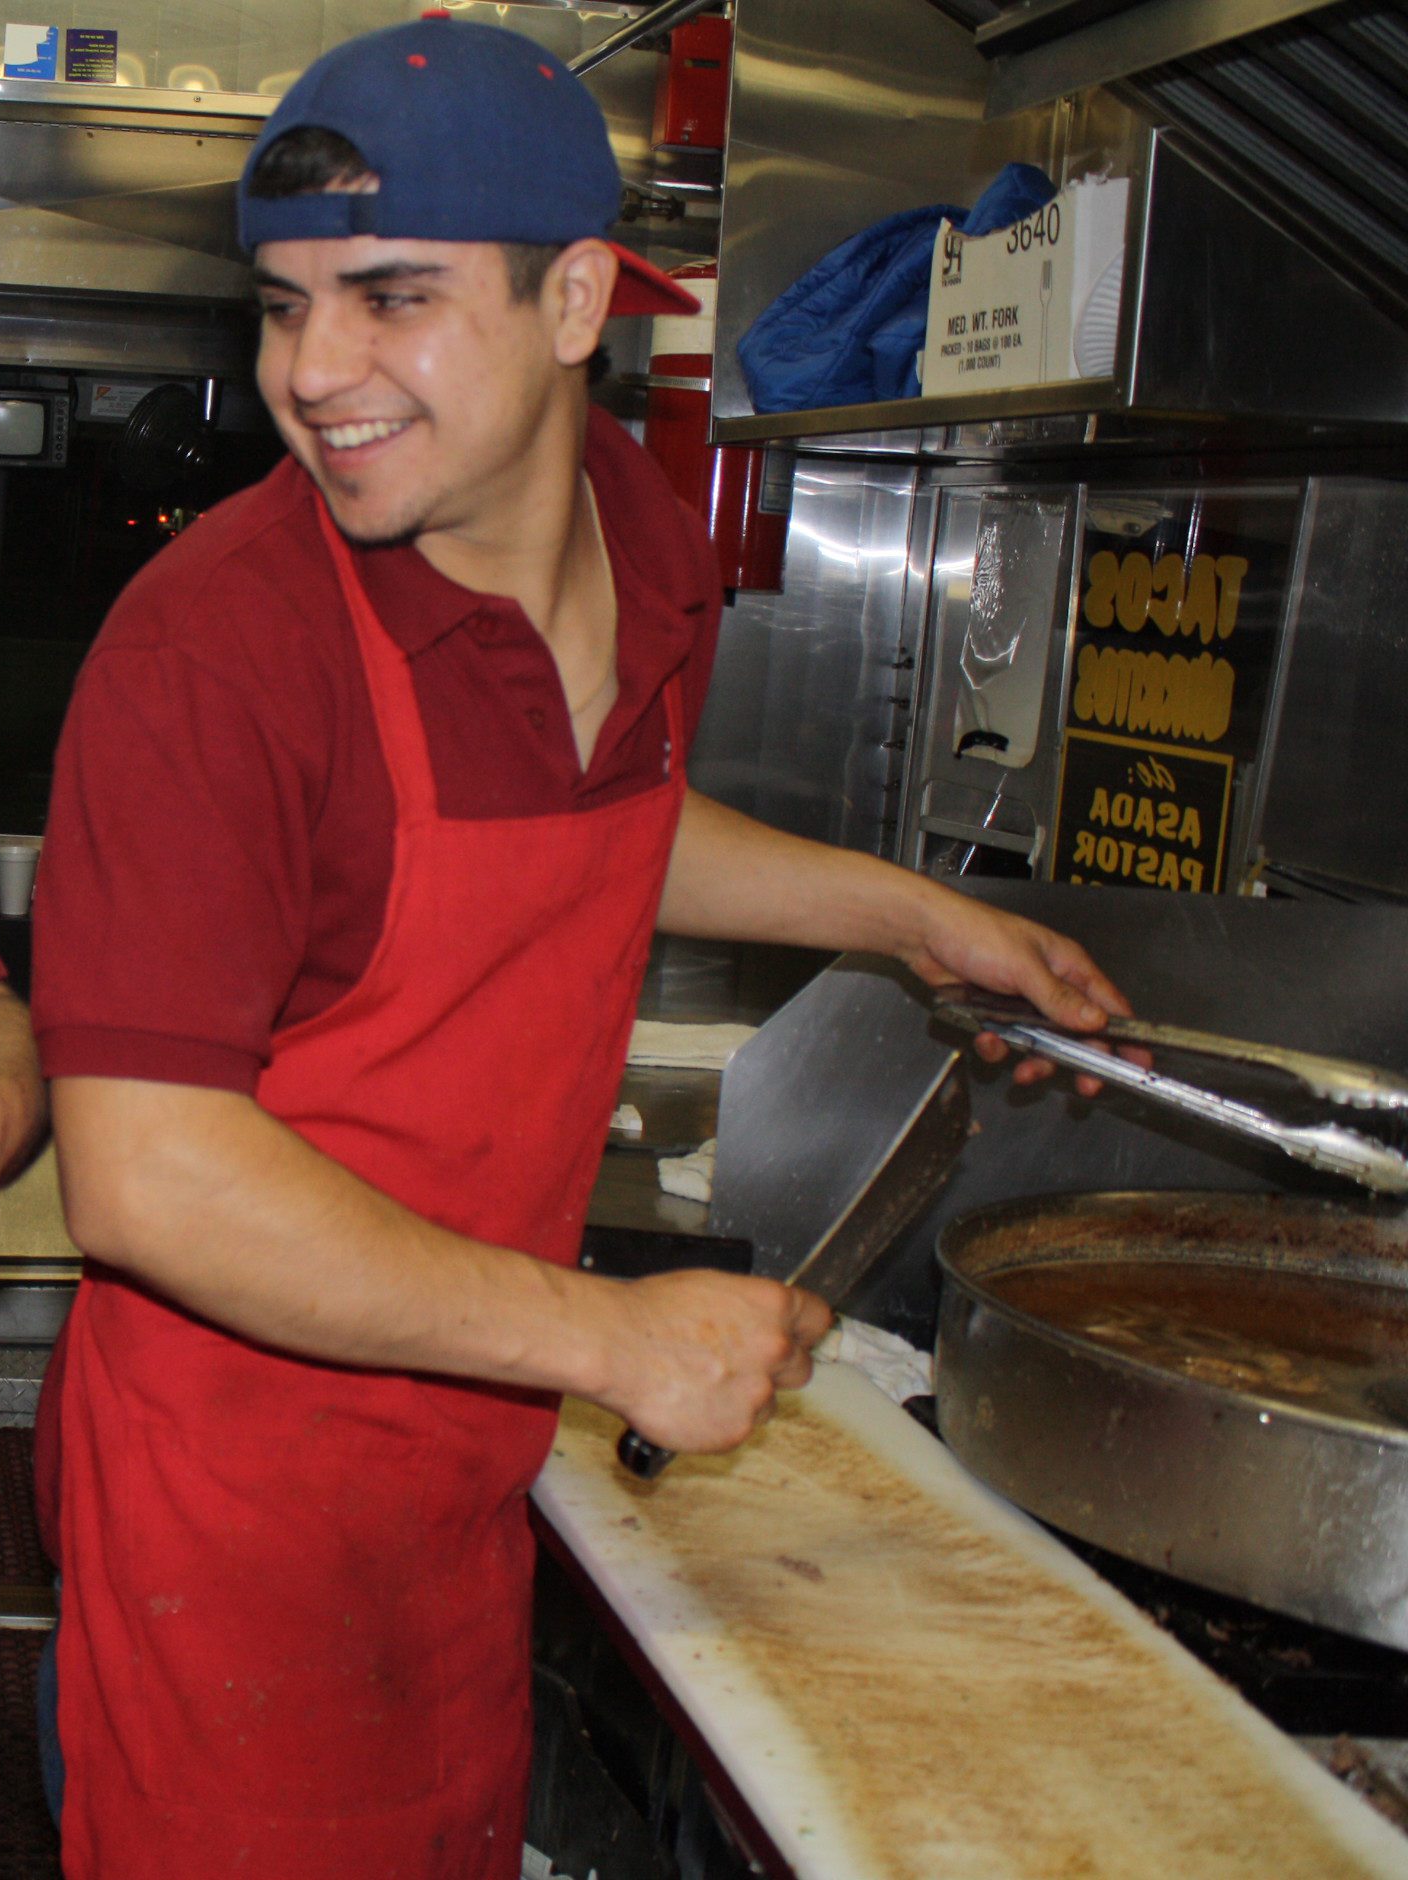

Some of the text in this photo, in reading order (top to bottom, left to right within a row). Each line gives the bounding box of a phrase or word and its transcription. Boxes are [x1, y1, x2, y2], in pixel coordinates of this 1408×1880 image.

[972, 311, 988, 332] WT.
[992, 305, 1019, 328] FORK
[974, 337, 990, 353] BAGS
